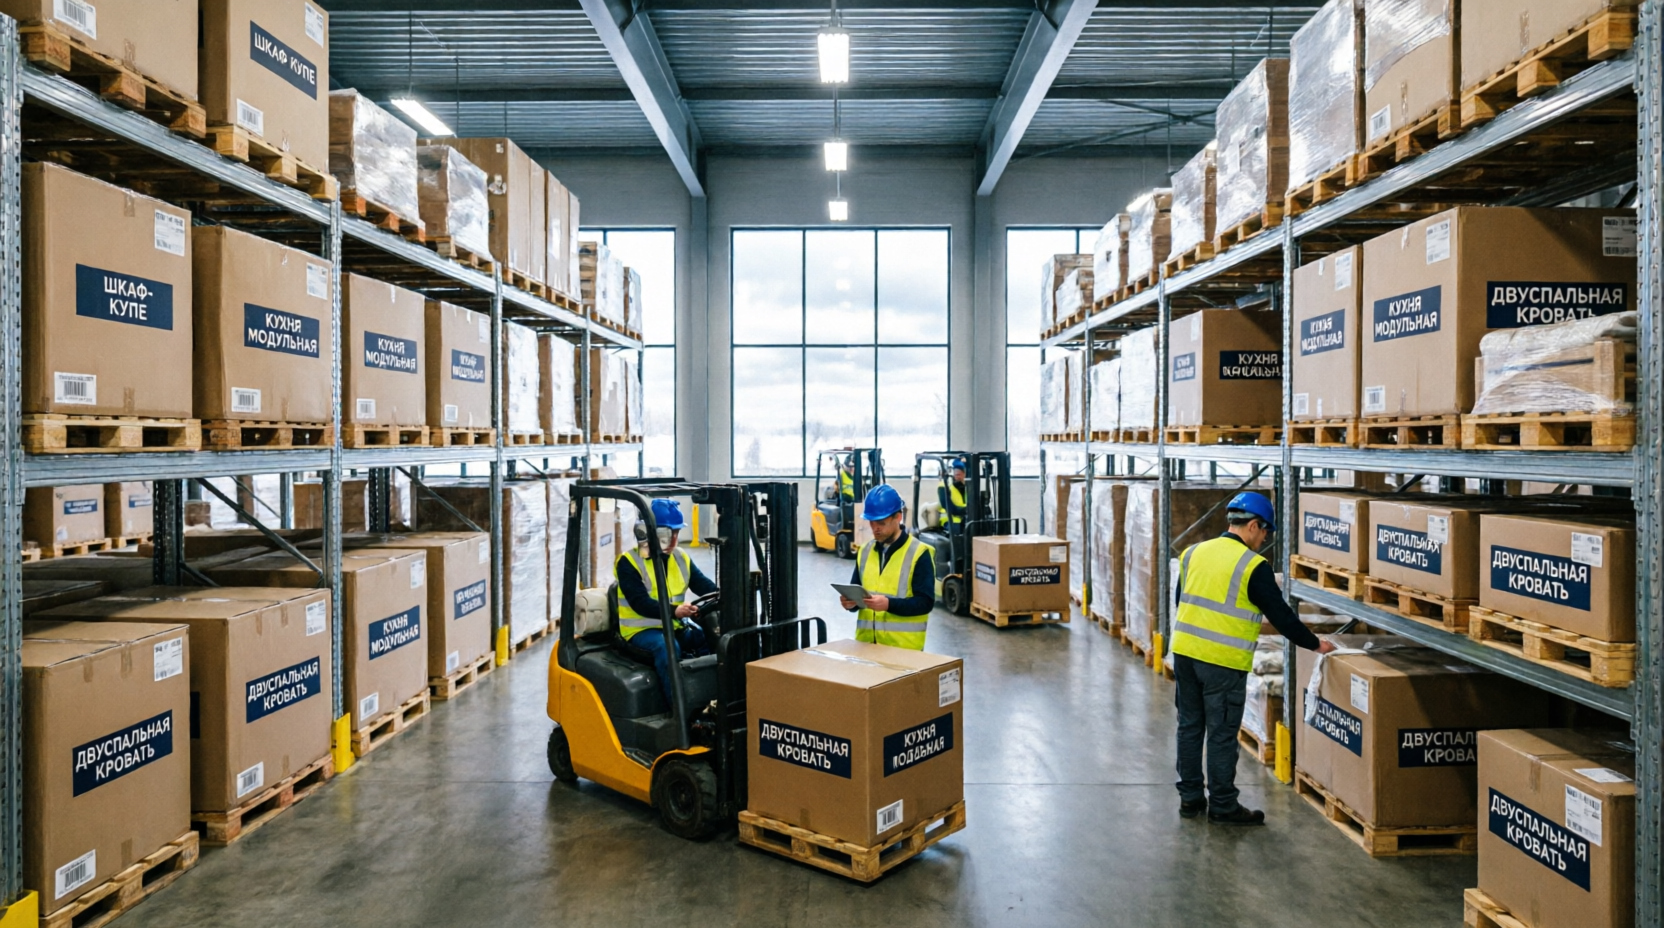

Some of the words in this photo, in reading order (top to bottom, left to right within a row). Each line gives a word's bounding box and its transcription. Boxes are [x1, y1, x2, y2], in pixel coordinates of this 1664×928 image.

[254, 32, 288, 65] ШКАФ
[290, 56, 316, 86] КУПЕ
[103, 275, 153, 299] ШКАФ-
[1491, 286, 1623, 306] ДВУСПАЛЬНАЯ
[109, 299, 148, 321] КУПЕ
[1388, 295, 1422, 317] КУХНЯ
[265, 312, 302, 333] КУХНЯ
[1374, 311, 1438, 338] МОДУЛЬНАЯ
[248, 327, 318, 354] МОДУЛЬНАЯ
[1388, 546, 1429, 567] КРОВАТЬ
[1492, 549, 1588, 585] ДВУСПАЛЬНАЯ
[1508, 571, 1569, 600] КРОВАТЬ
[247, 661, 319, 704] ДВУСПАЛЬНАЯ
[263, 682, 308, 711] КРОВАТЬ
[75, 716, 171, 772] ДВУСПАЛЬНАЯ
[761, 722, 849, 758] ДВУСПАЛЬНАЯ
[904, 722, 936, 748] КУХНЯ
[1401, 731, 1477, 749] ДВУСПАЛ
[95, 743, 155, 781] КРОВАТЬ
[777, 743, 832, 770] КРОВАТЬ
[1424, 748, 1476, 764] КРОВА
[1490, 793, 1587, 862] ДВУСПАЛЬНАЯ
[1507, 820, 1567, 872] КРОВАТЬ
